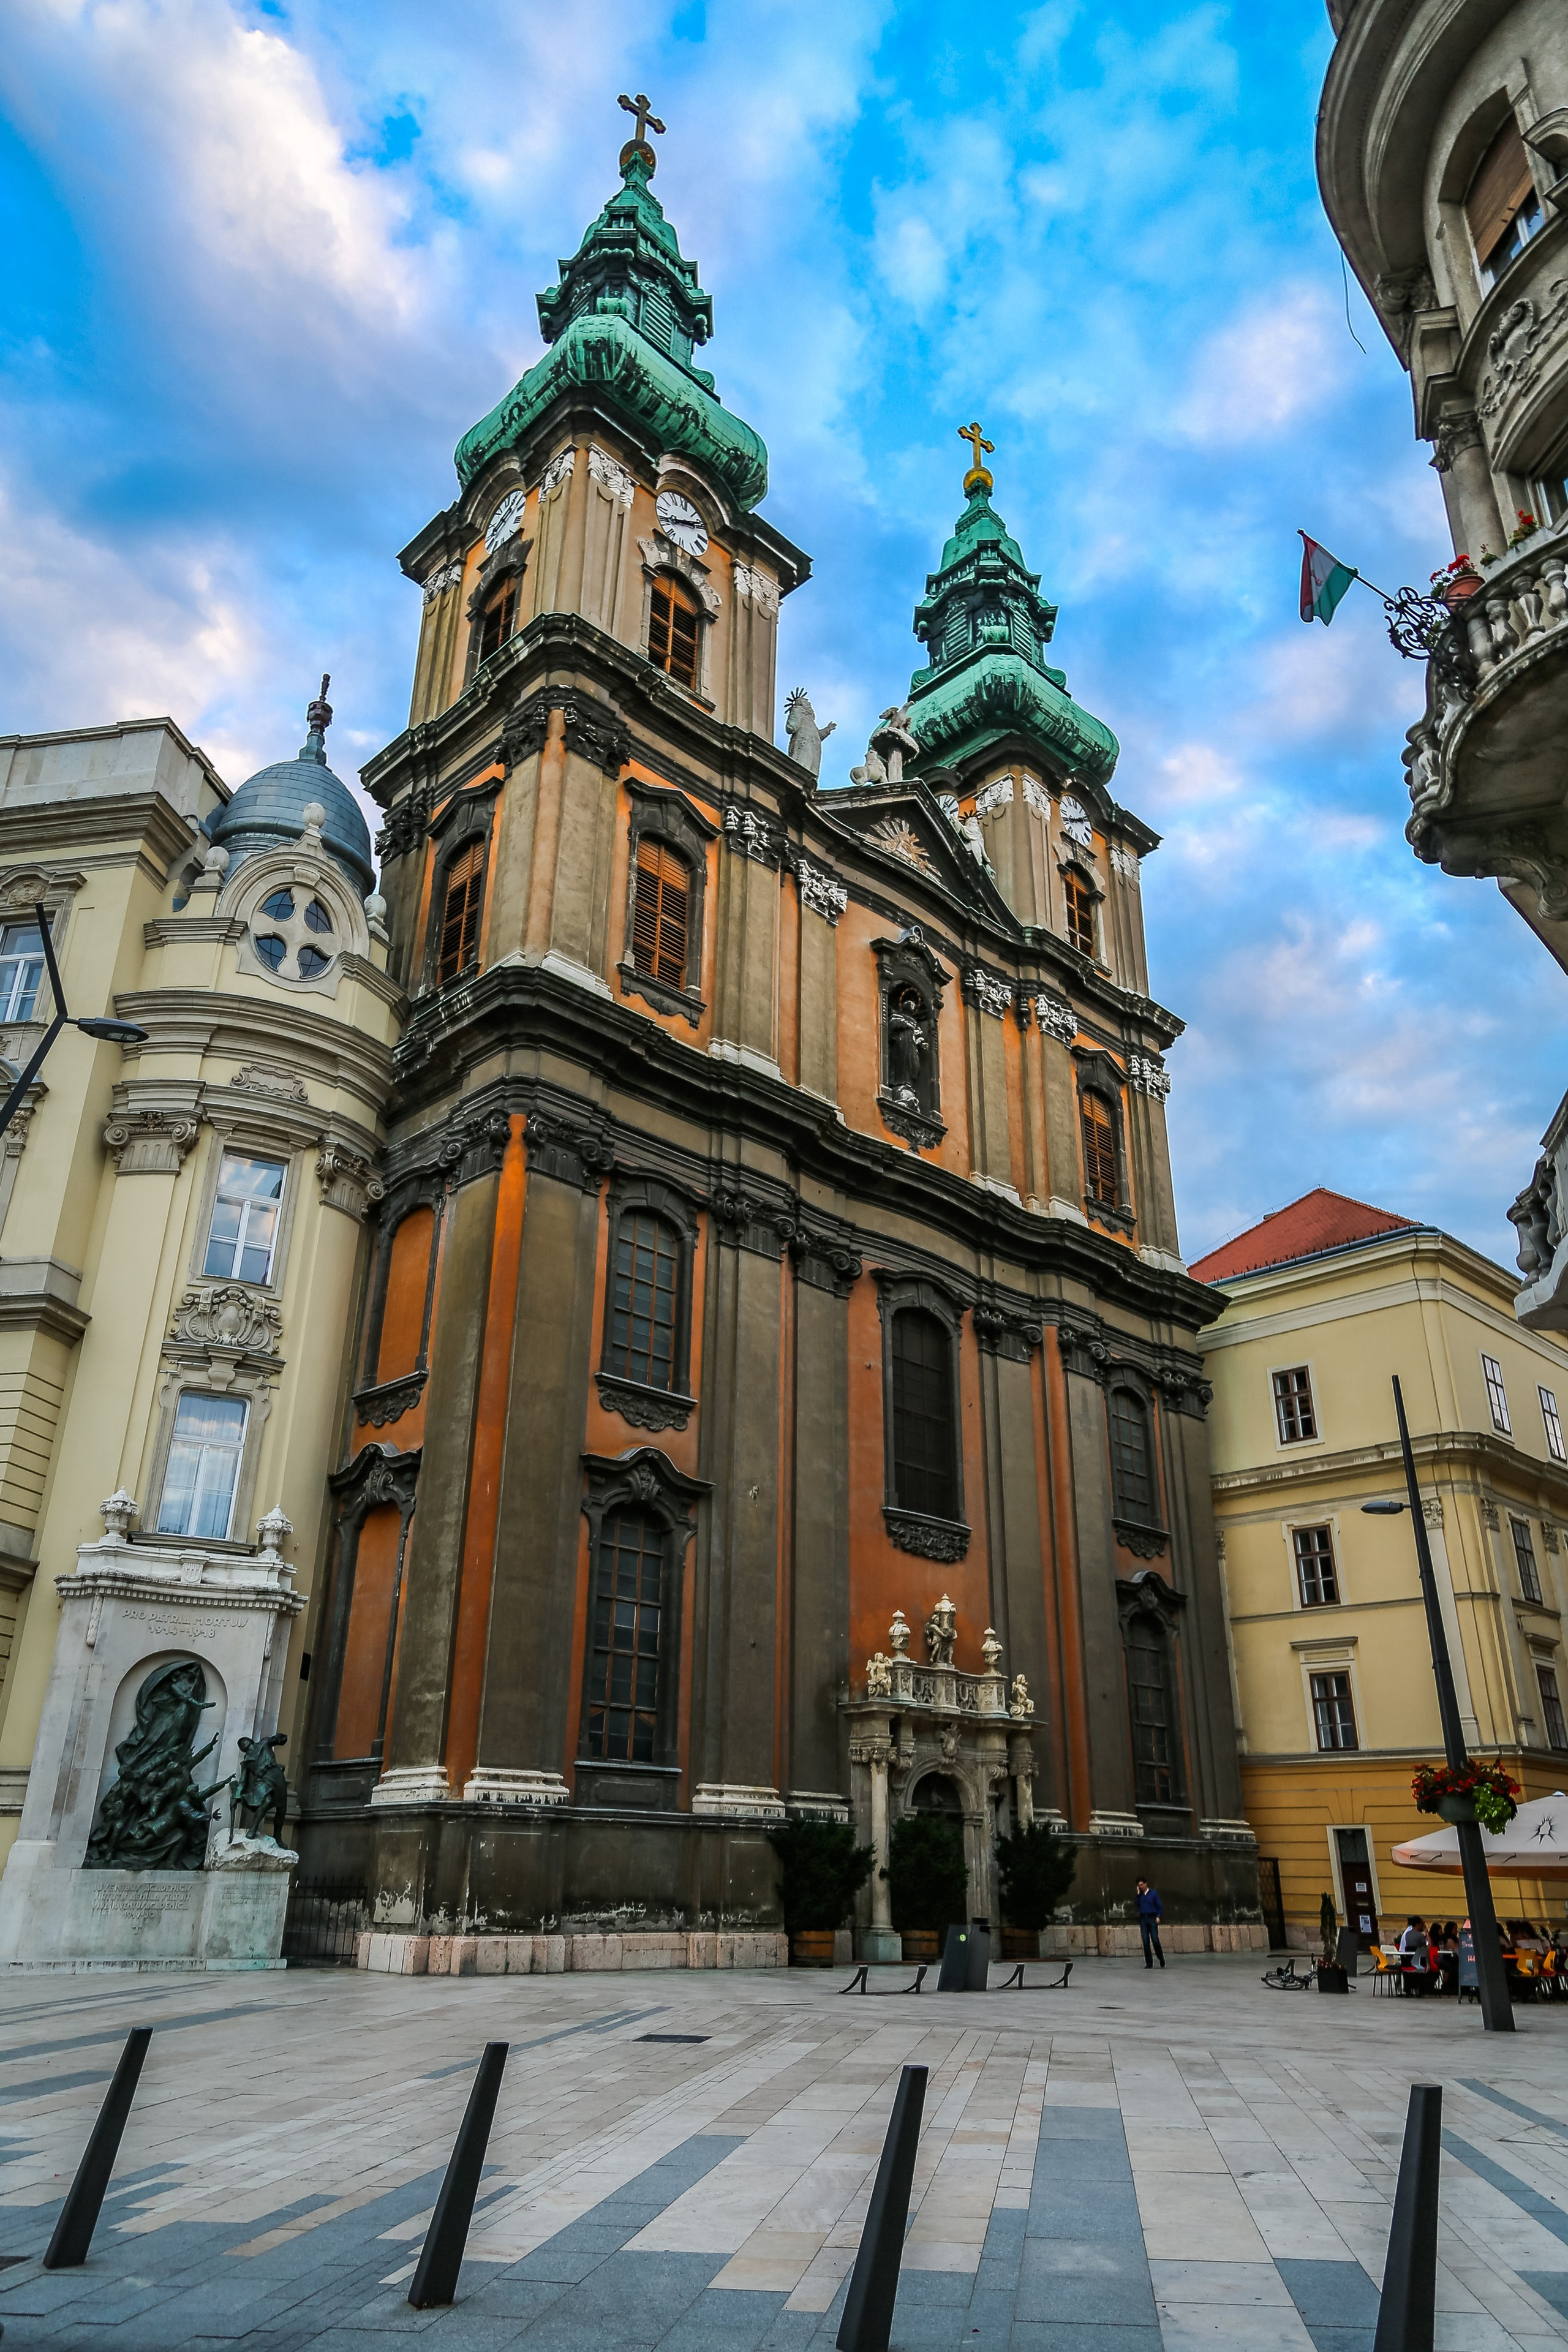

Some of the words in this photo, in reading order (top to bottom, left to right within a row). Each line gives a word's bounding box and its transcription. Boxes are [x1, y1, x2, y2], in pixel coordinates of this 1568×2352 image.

[123, 1608, 147, 1620] PRO
[148, 1612, 190, 1626] PATRIA
[193, 1616, 249, 1628] MORTUIS
[144, 1883, 192, 1893] ACADEMICIS
[145, 1901, 189, 1911] ACADEMICA
